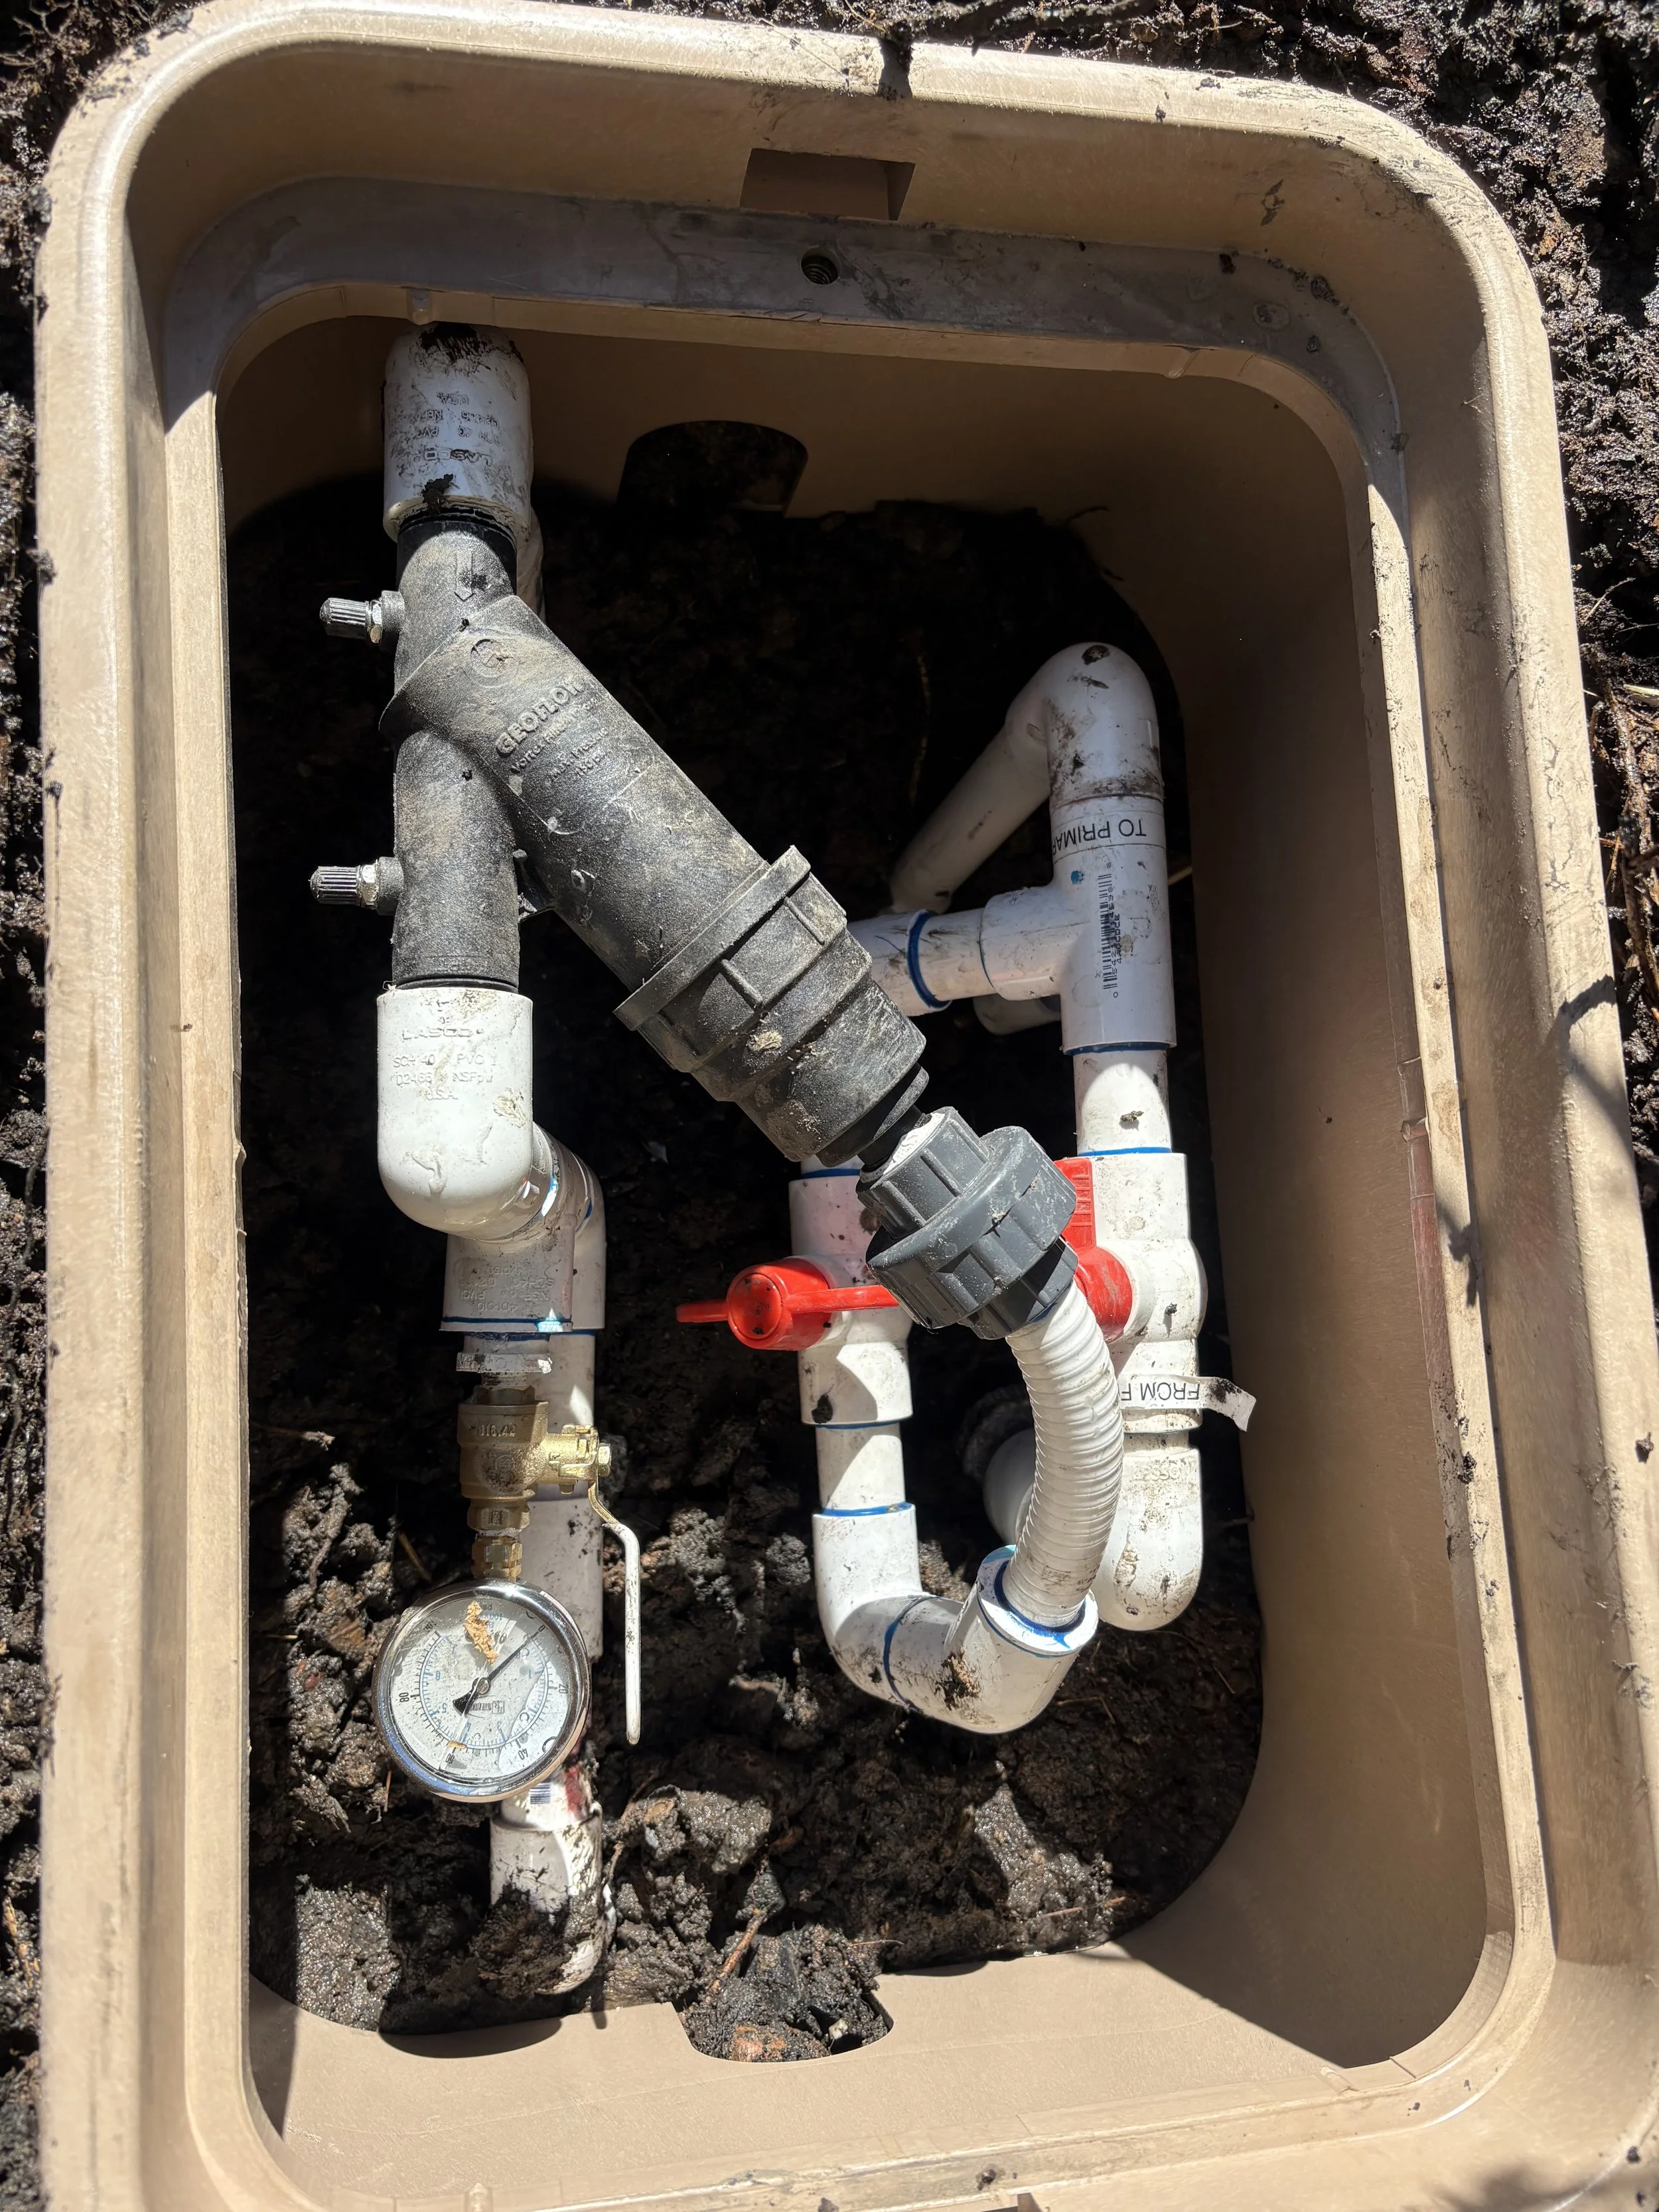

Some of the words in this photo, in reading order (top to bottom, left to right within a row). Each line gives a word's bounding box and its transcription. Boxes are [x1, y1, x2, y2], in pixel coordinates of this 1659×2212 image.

[1119, 819, 1147, 837] TO
[1139, 1382, 1200, 1402] FROM
[398, 1692, 410, 1703] 80
[518, 1749, 529, 1761] 40
